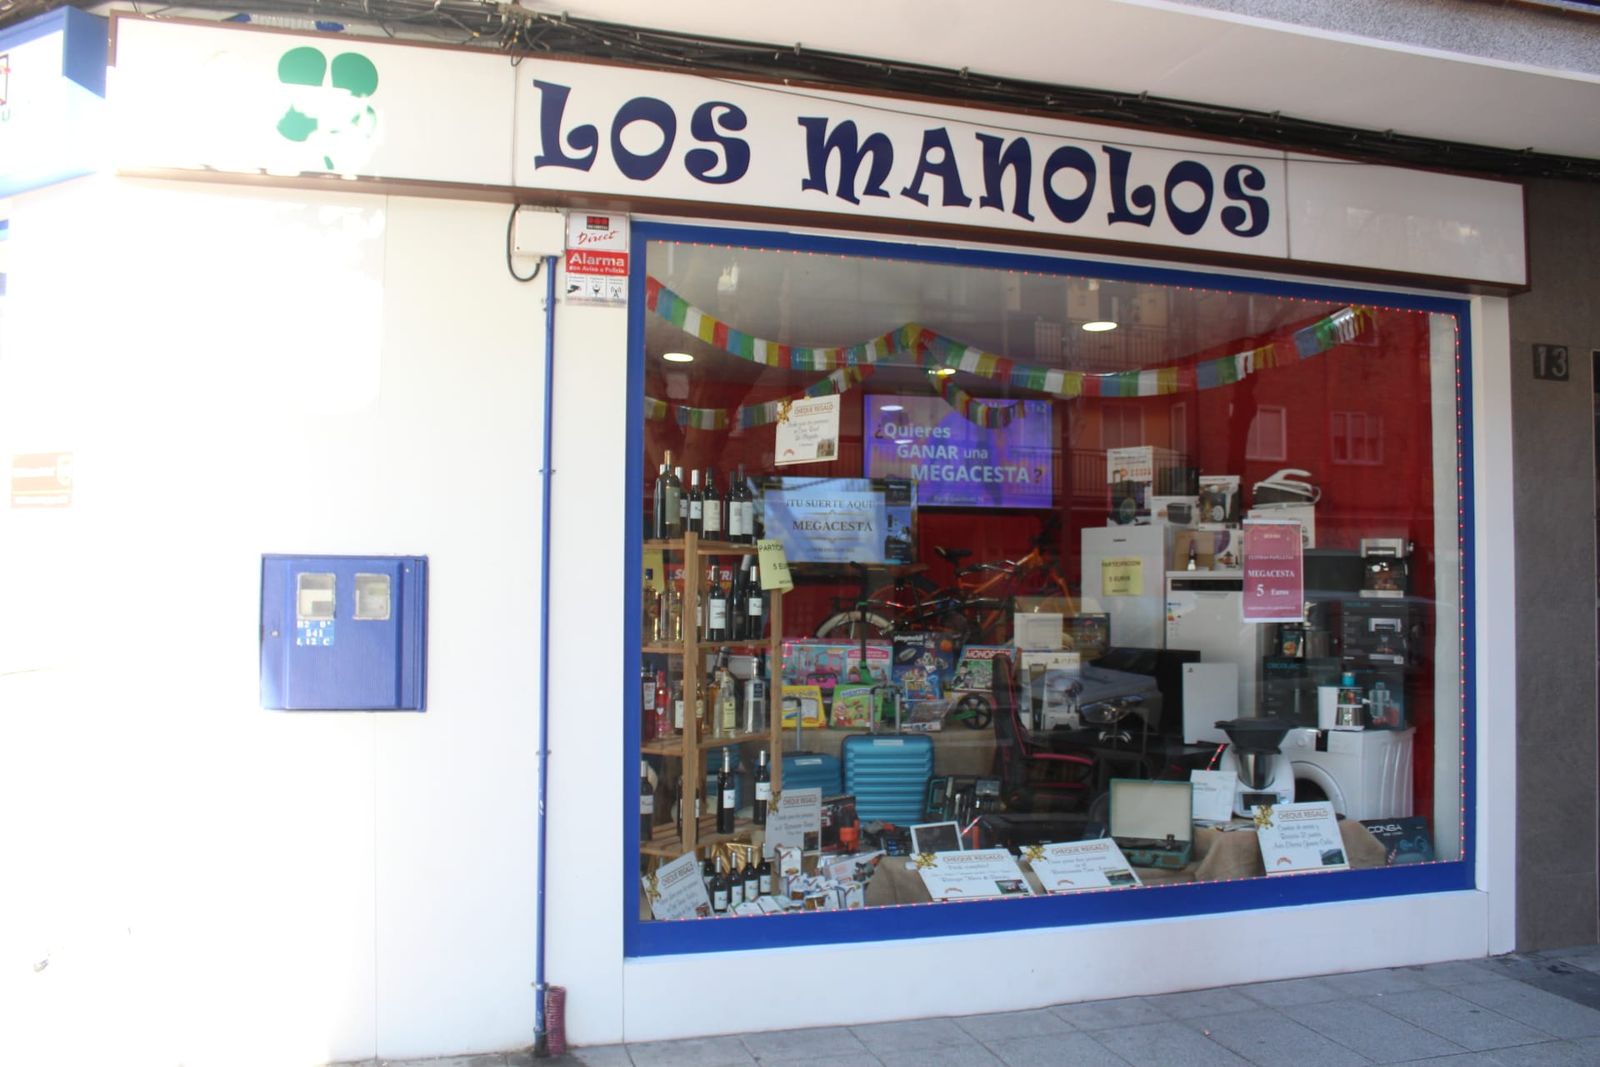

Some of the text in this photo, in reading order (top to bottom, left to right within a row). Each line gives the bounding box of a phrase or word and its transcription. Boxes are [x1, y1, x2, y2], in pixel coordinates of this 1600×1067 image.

[532, 78, 1270, 238] LOS MANOLOS
[569, 252, 625, 267] Alarma
[1538, 346, 1567, 377] 13
[897, 444, 989, 460] GANAR una
[911, 464, 1030, 483] MEGACESTA
[805, 500, 843, 509] SUERTE
[792, 520, 873, 532] MEGACESTA
[1248, 569, 1295, 578] MEGACESTA
[1256, 584, 1264, 597] 5
